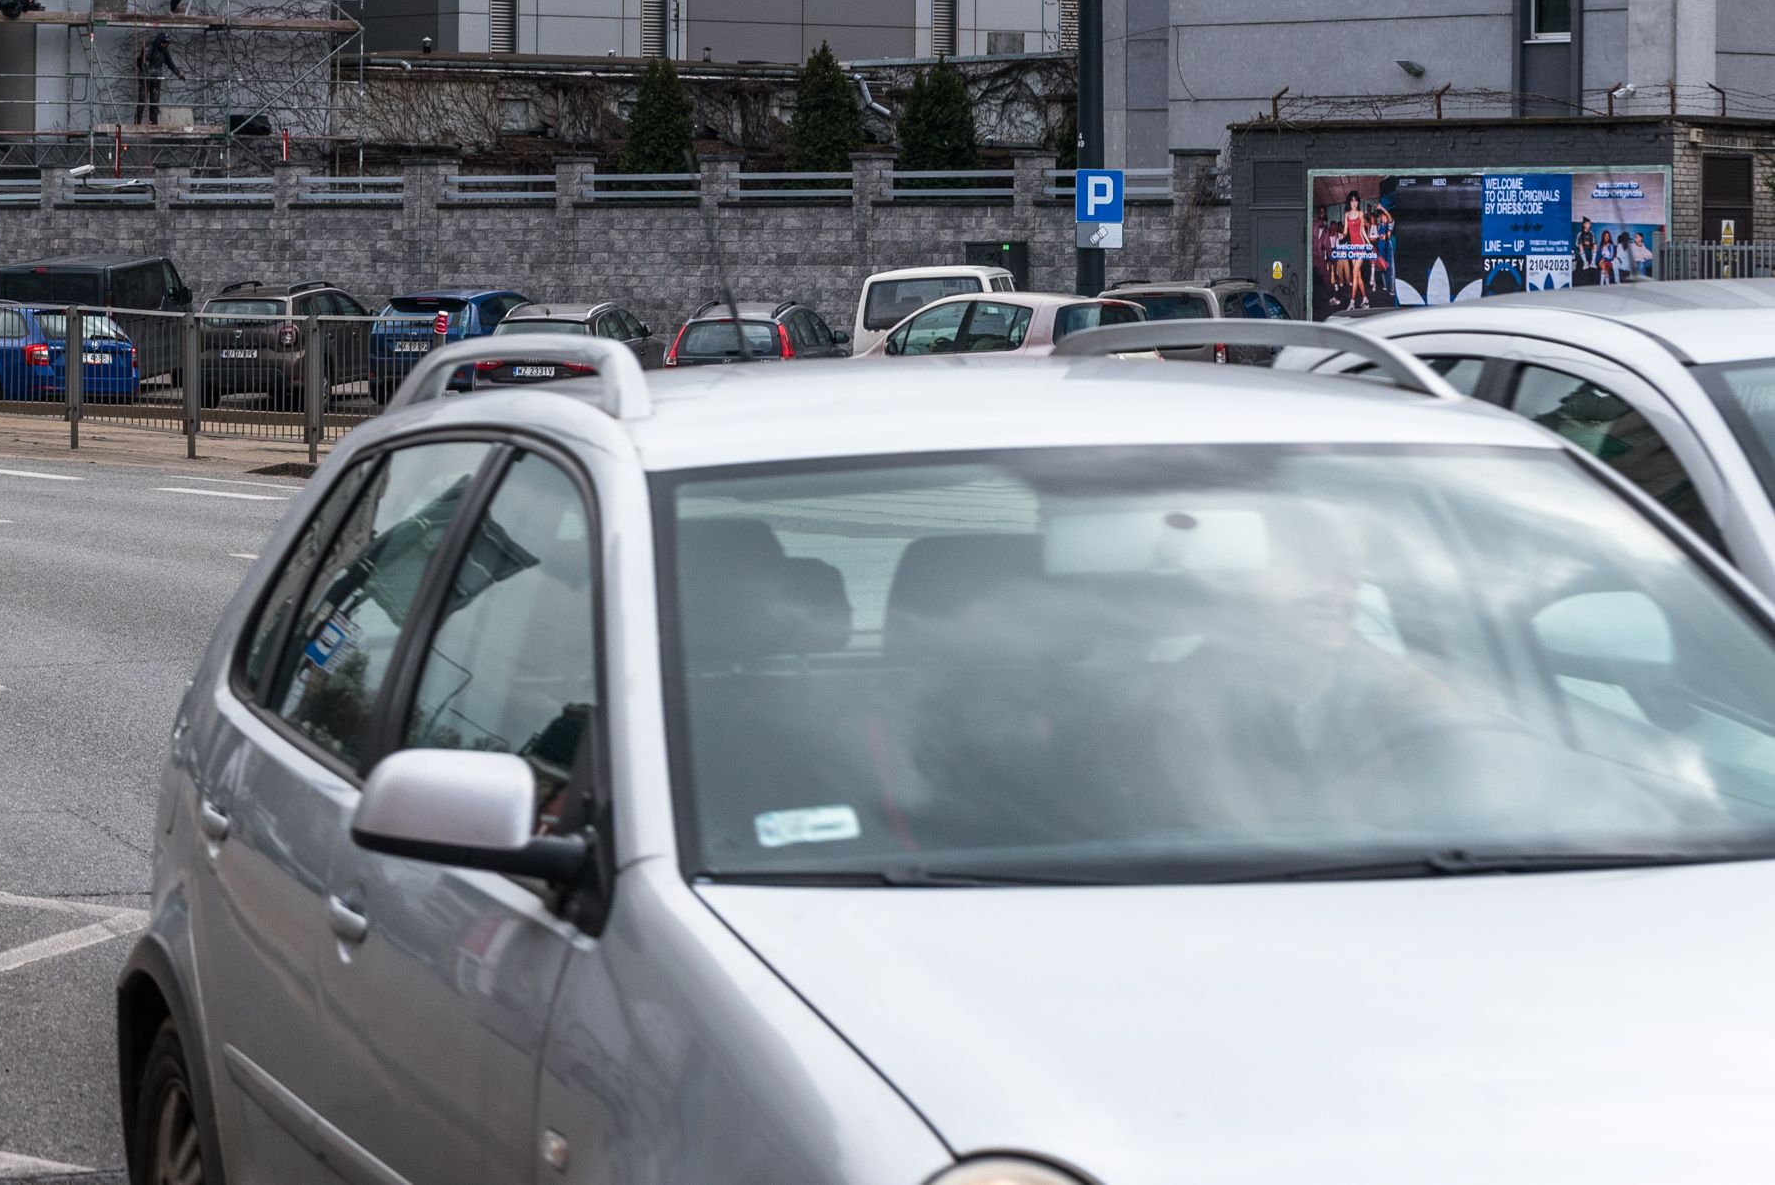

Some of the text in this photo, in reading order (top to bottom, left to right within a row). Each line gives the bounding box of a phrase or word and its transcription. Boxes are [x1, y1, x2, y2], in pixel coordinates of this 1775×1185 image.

[1485, 178, 1524, 190] WELCOME
[1088, 176, 1114, 216] P
[1485, 190, 1560, 202] TO CLUB ORIGINALS
[1611, 189, 1643, 198] Originals
[1485, 203, 1494, 214] BY
[1484, 240, 1502, 252] LINE
[1513, 240, 1524, 252] UP
[1348, 251, 1377, 259] Originals
[1530, 259, 1569, 271] 21042023
